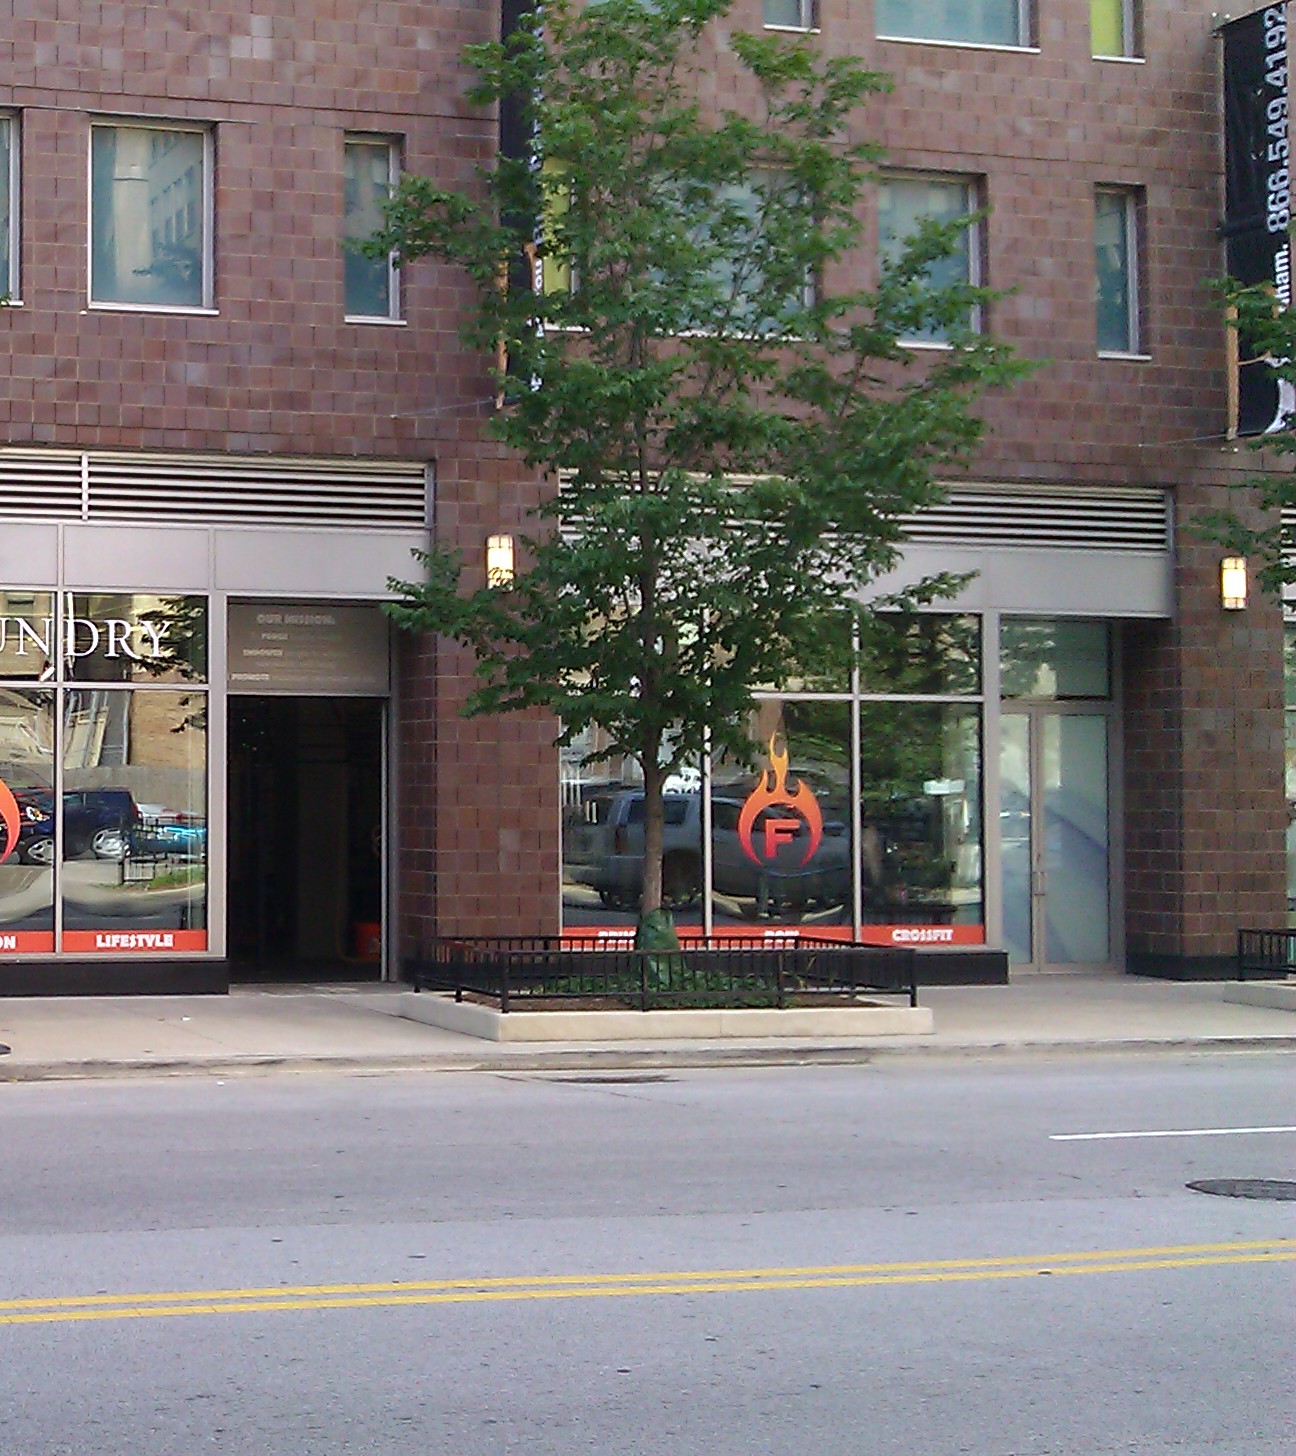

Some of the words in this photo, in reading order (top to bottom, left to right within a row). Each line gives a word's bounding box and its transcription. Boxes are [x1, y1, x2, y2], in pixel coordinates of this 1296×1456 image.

[1264, 3, 1291, 233] 866.549.4192
[765, 819, 800, 858] F
[95, 934, 174, 948] LIFESTYLE
[892, 928, 954, 942] CROSSFIT
